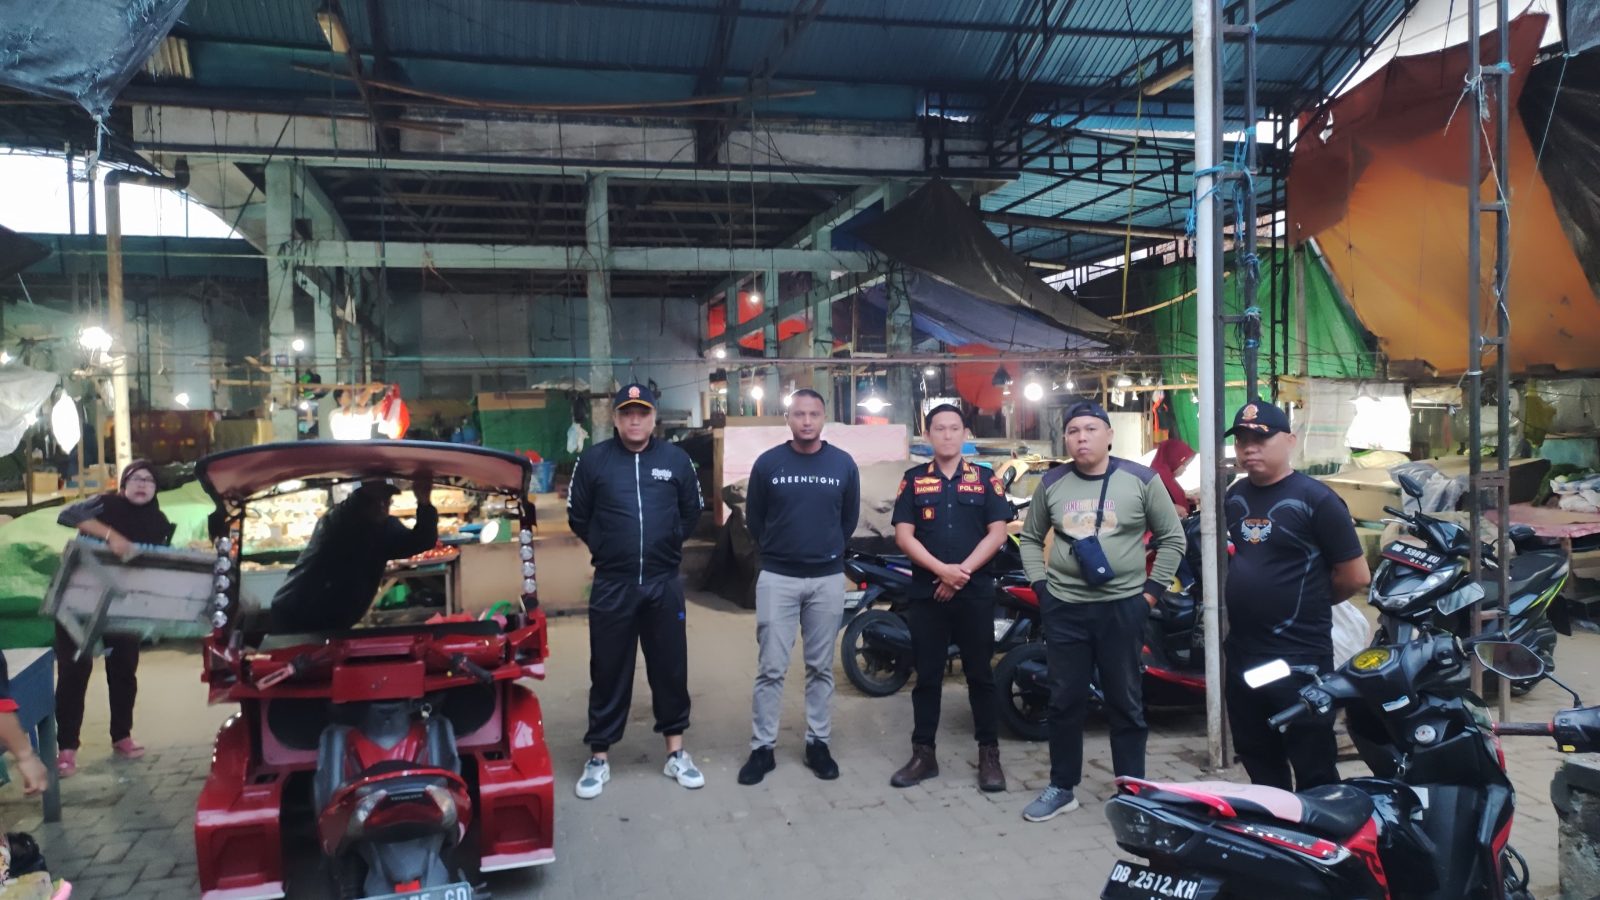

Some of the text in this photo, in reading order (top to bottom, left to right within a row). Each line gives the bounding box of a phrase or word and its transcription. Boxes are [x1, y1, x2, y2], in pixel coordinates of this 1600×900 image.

[772, 475, 840, 487] GREENLIGHT
[1110, 864, 1198, 900] DB 2512 KH
